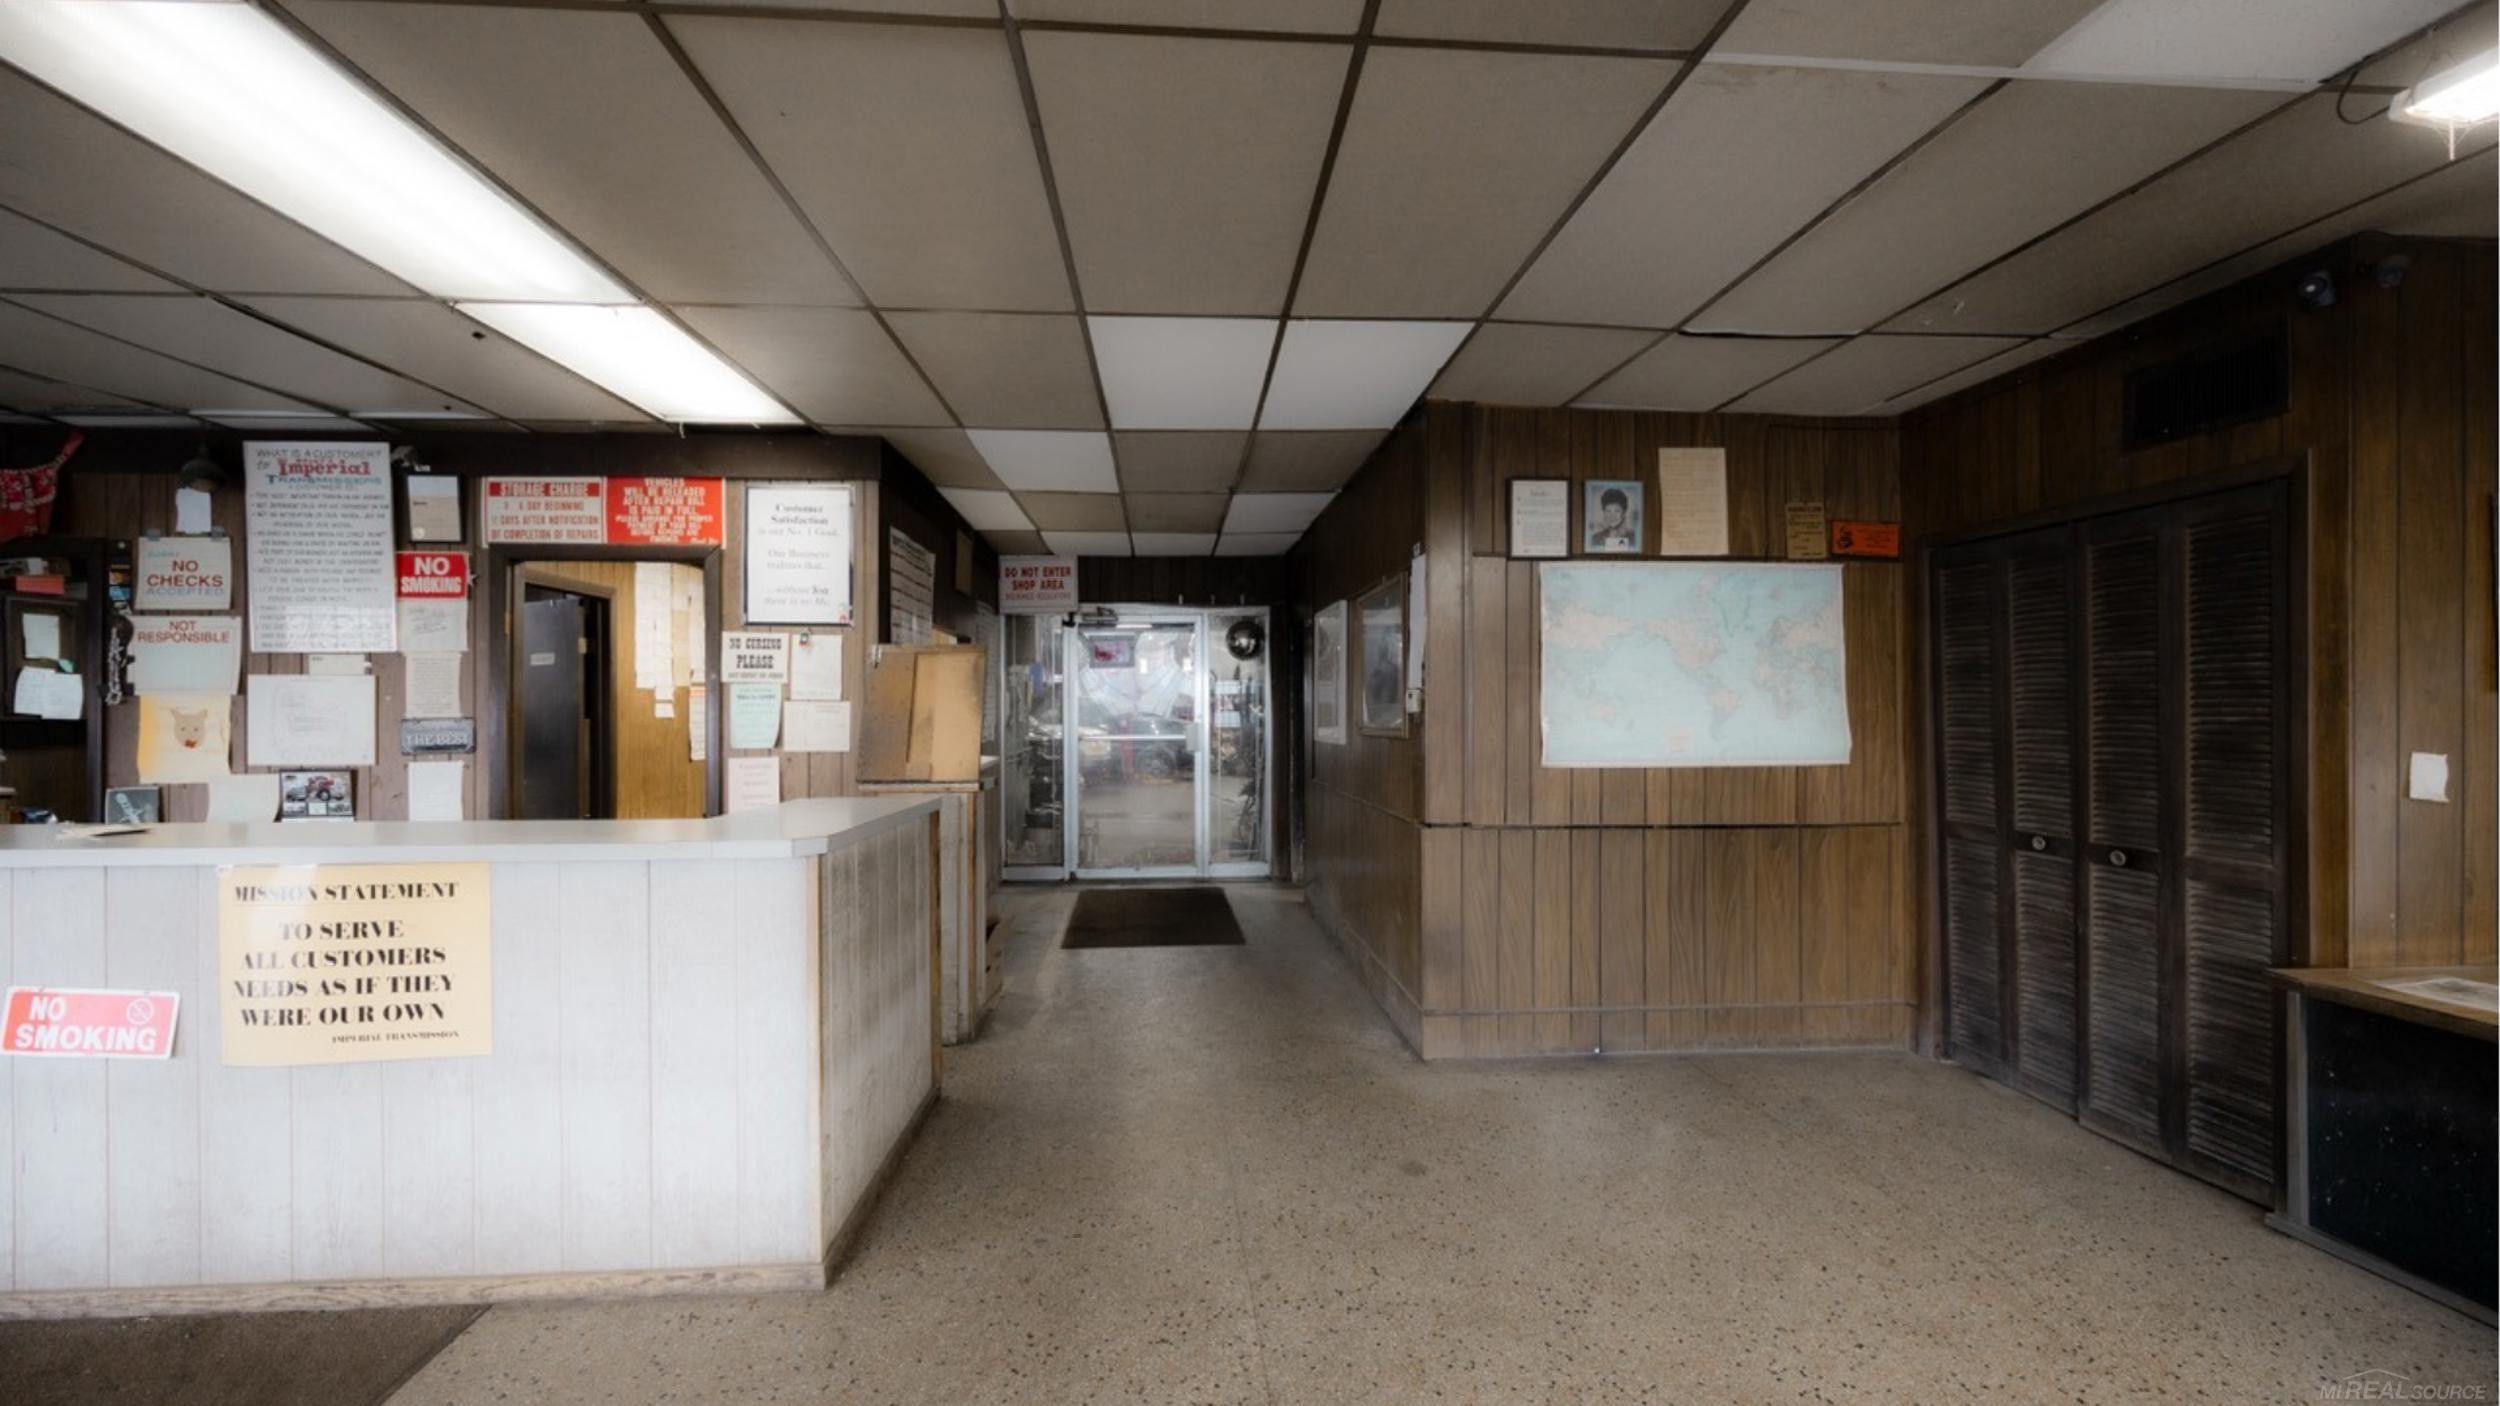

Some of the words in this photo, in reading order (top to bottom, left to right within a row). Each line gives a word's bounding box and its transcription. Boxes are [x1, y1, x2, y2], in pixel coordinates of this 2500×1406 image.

[256, 449, 288, 458] WHAT
[291, 449, 302, 458] IS
[305, 449, 312, 458] A
[277, 458, 371, 477] Imperial
[499, 482, 545, 497] STORAGE
[550, 482, 588, 497] CHARGE
[544, 501, 584, 511] BEGINNING
[776, 504, 823, 513] Customer
[523, 515, 545, 525] AFTER
[548, 515, 599, 525] NOTIFICATION
[771, 515, 828, 524] Satisfaction
[504, 529, 551, 540] COMPLETION
[171, 560, 199, 573] NO
[413, 556, 451, 577] NO
[1004, 566, 1018, 578] DO
[1020, 566, 1039, 578] NOT
[1042, 566, 1071, 578] ENTER
[146, 574, 224, 587] CHECKS
[401, 576, 462, 594] SMOKING
[1012, 579, 1036, 591] SHOP
[1041, 579, 1065, 591] AREA
[146, 588, 225, 597] ACCEPTED
[169, 620, 197, 631] NOT
[137, 631, 230, 644] RESPONSIBLE
[736, 654, 774, 669] PLEASE
[234, 885, 318, 902] MISSION
[324, 882, 460, 901] STATEMENT
[279, 922, 313, 941] TO
[319, 919, 405, 940] SERVE
[240, 951, 285, 970] ALL
[290, 947, 447, 969] CUSTOMERS
[233, 979, 308, 998] NEEDS
[318, 979, 347, 996] AS
[355, 976, 380, 995] IF
[386, 974, 454, 994] THEY
[29, 996, 66, 1021] NO
[240, 1007, 312, 1026] WERE
[319, 1005, 375, 1026] OUR
[382, 1002, 446, 1023] OWN
[15, 1024, 157, 1051] SMOKING
[331, 1034, 382, 1044] IMPERIAL
[386, 1030, 460, 1042] TRANSMISSION
